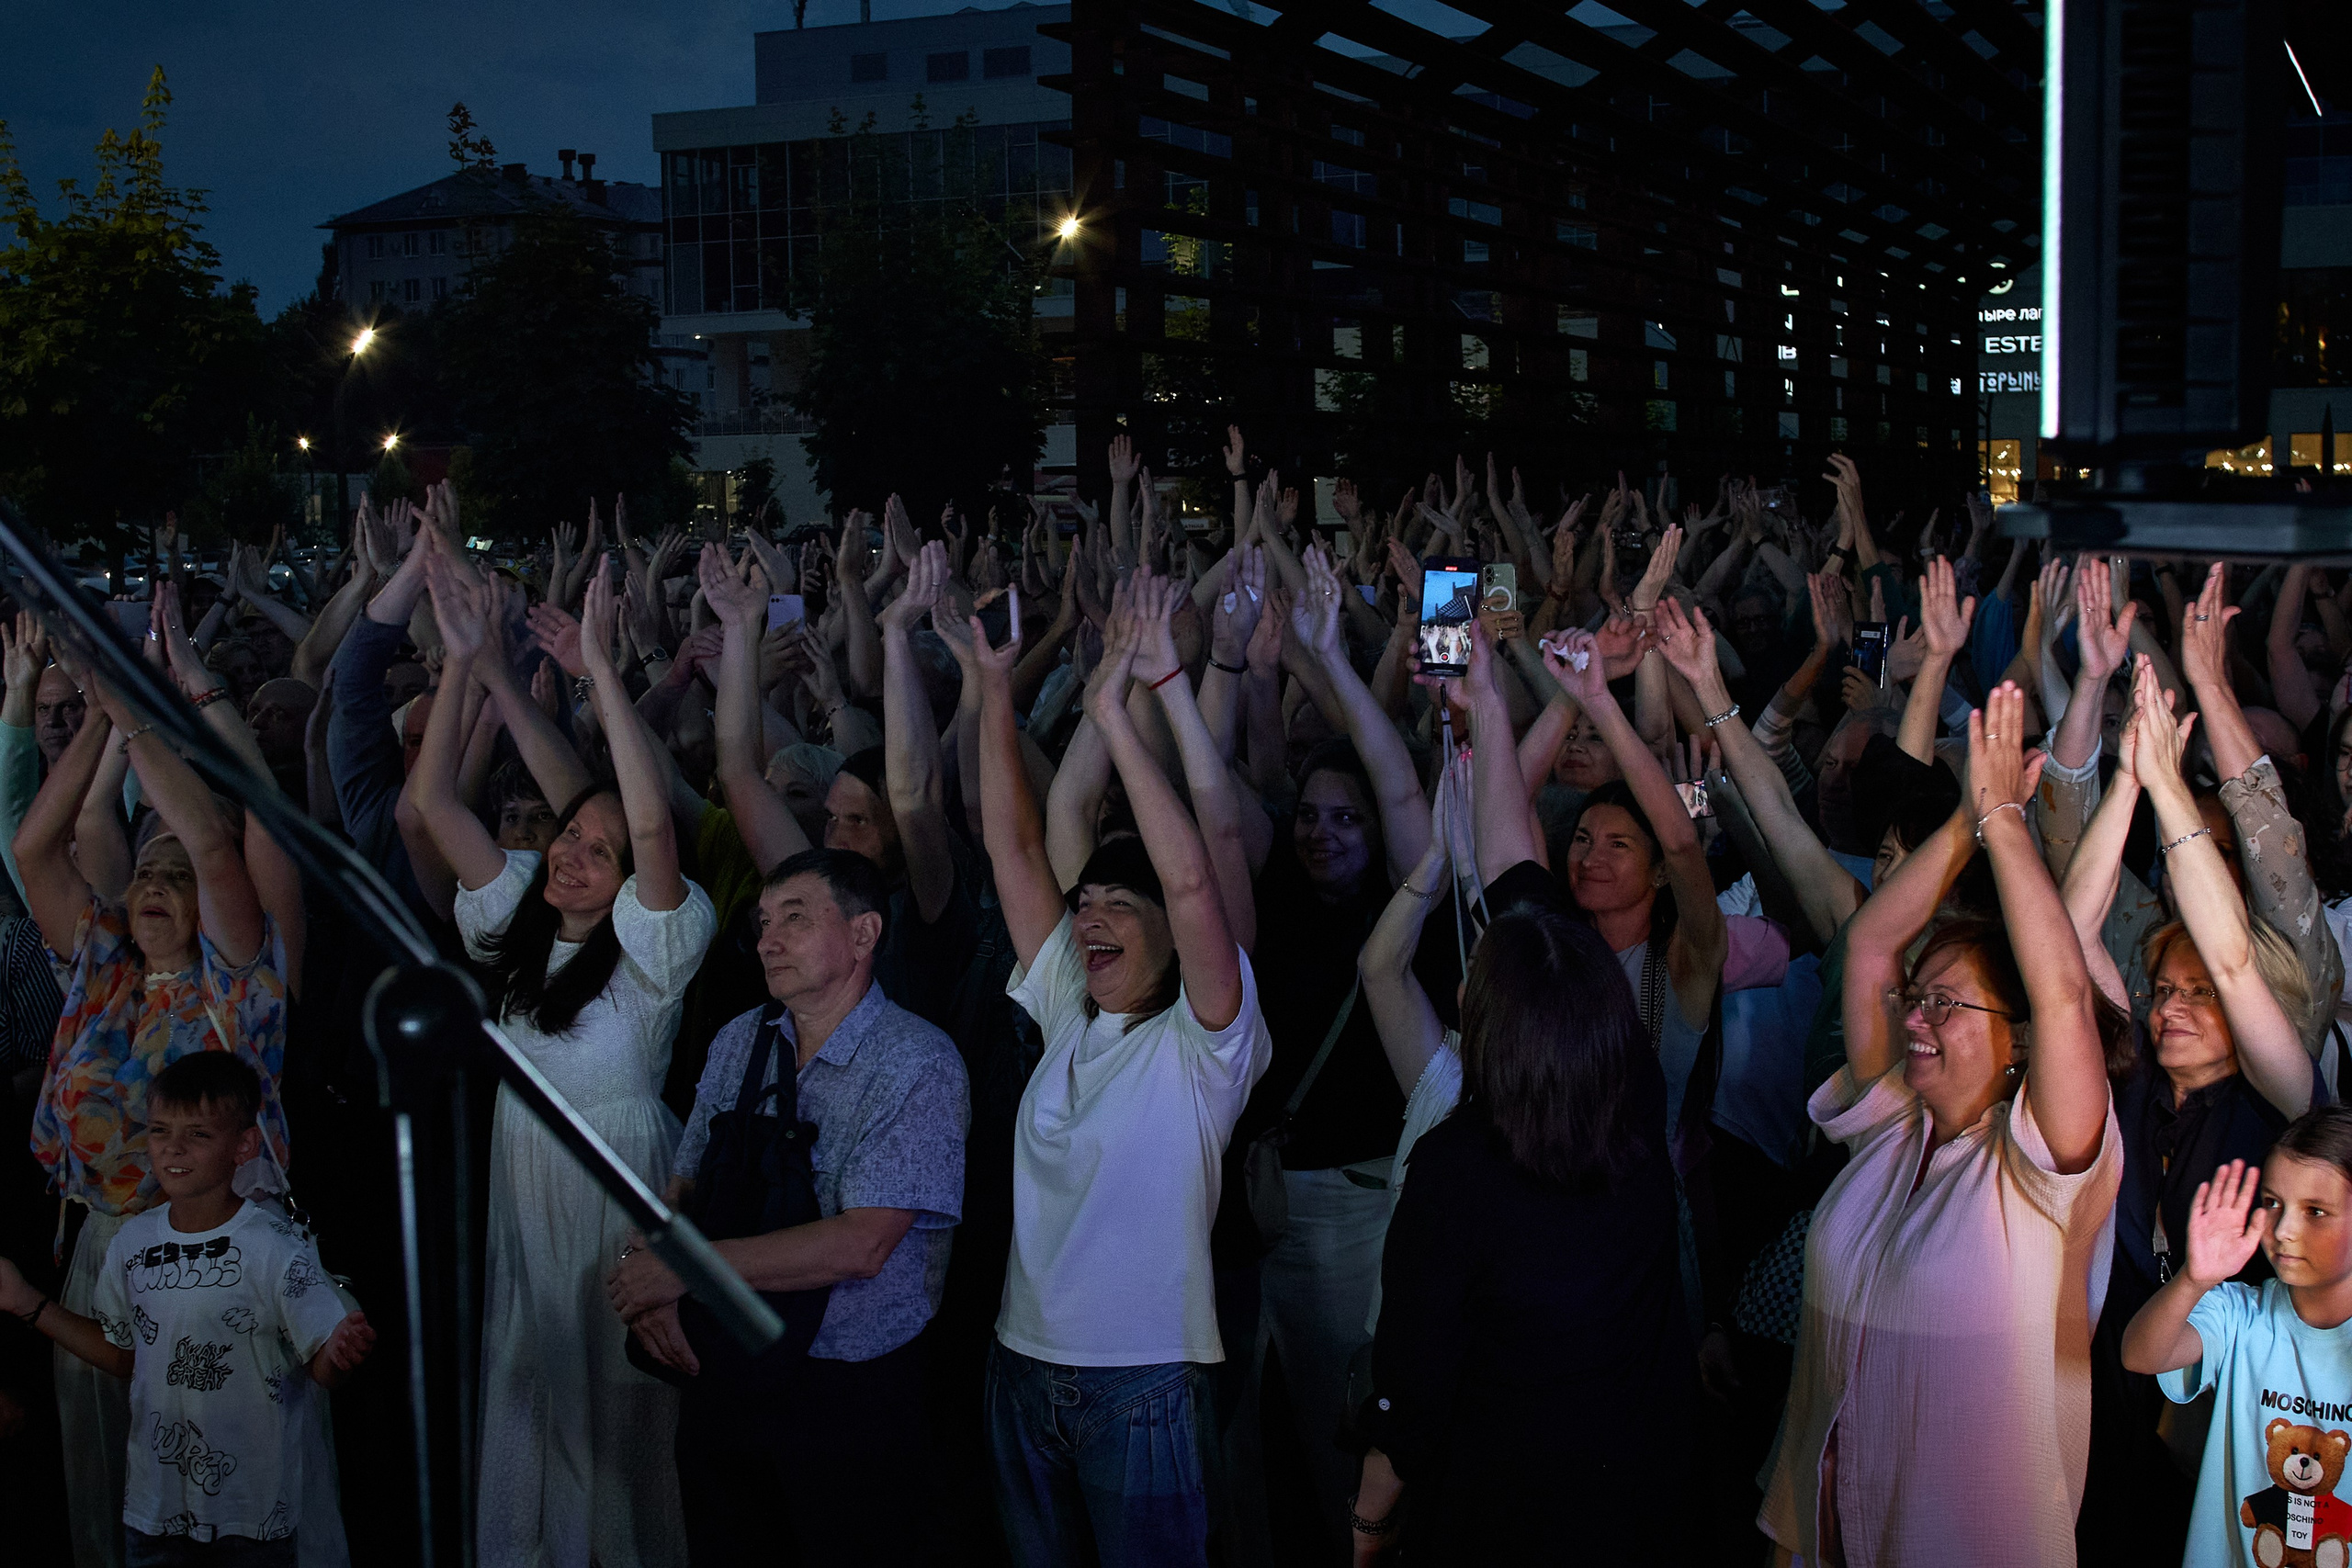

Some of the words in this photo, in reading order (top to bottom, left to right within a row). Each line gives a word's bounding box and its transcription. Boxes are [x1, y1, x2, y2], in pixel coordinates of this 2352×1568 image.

[175, 1335, 233, 1368] OKAY
[167, 1363, 233, 1391] GREAT
[2294, 1497, 2302, 1506] IS
[2303, 1499, 2322, 1508] NOT
[2291, 1529, 2308, 1540] TOY
